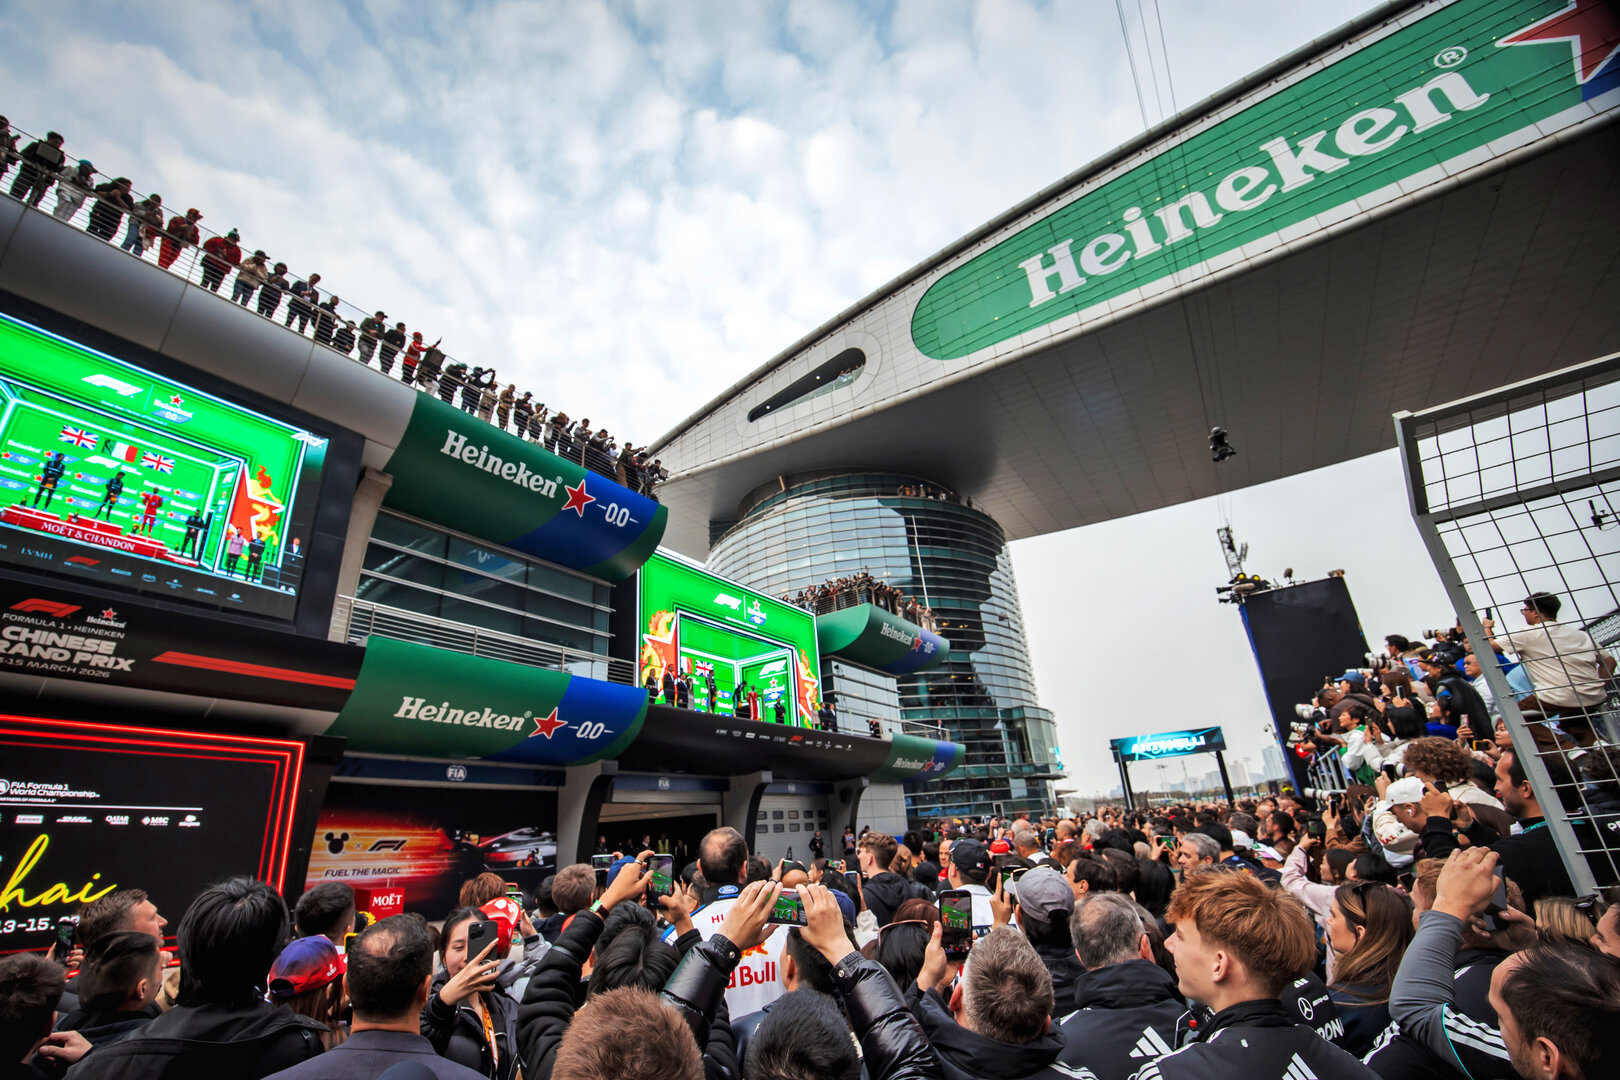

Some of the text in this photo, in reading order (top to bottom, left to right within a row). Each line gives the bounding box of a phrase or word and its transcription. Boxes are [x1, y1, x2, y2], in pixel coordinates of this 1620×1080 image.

[84, 533, 136, 551] CHANDON
[2, 612, 56, 628] FORMULA
[73, 624, 126, 639] HEINEKEN
[1, 625, 117, 655] CHINESE
[26, 660, 77, 674] MARCH
[78, 667, 111, 678] 2026
[72, 651, 136, 672] PRIX
[448, 767, 465, 779] FIA
[10, 781, 26, 789] FIA
[27, 782, 63, 790] Formula
[658, 778, 670, 788] FIA
[9, 788, 96, 798] World Championship
[0, 834, 117, 912] hai
[324, 866, 402, 877] FUEL THE MAGIC
[371, 892, 403, 907] MOËT
[739, 961, 776, 987] Bull
